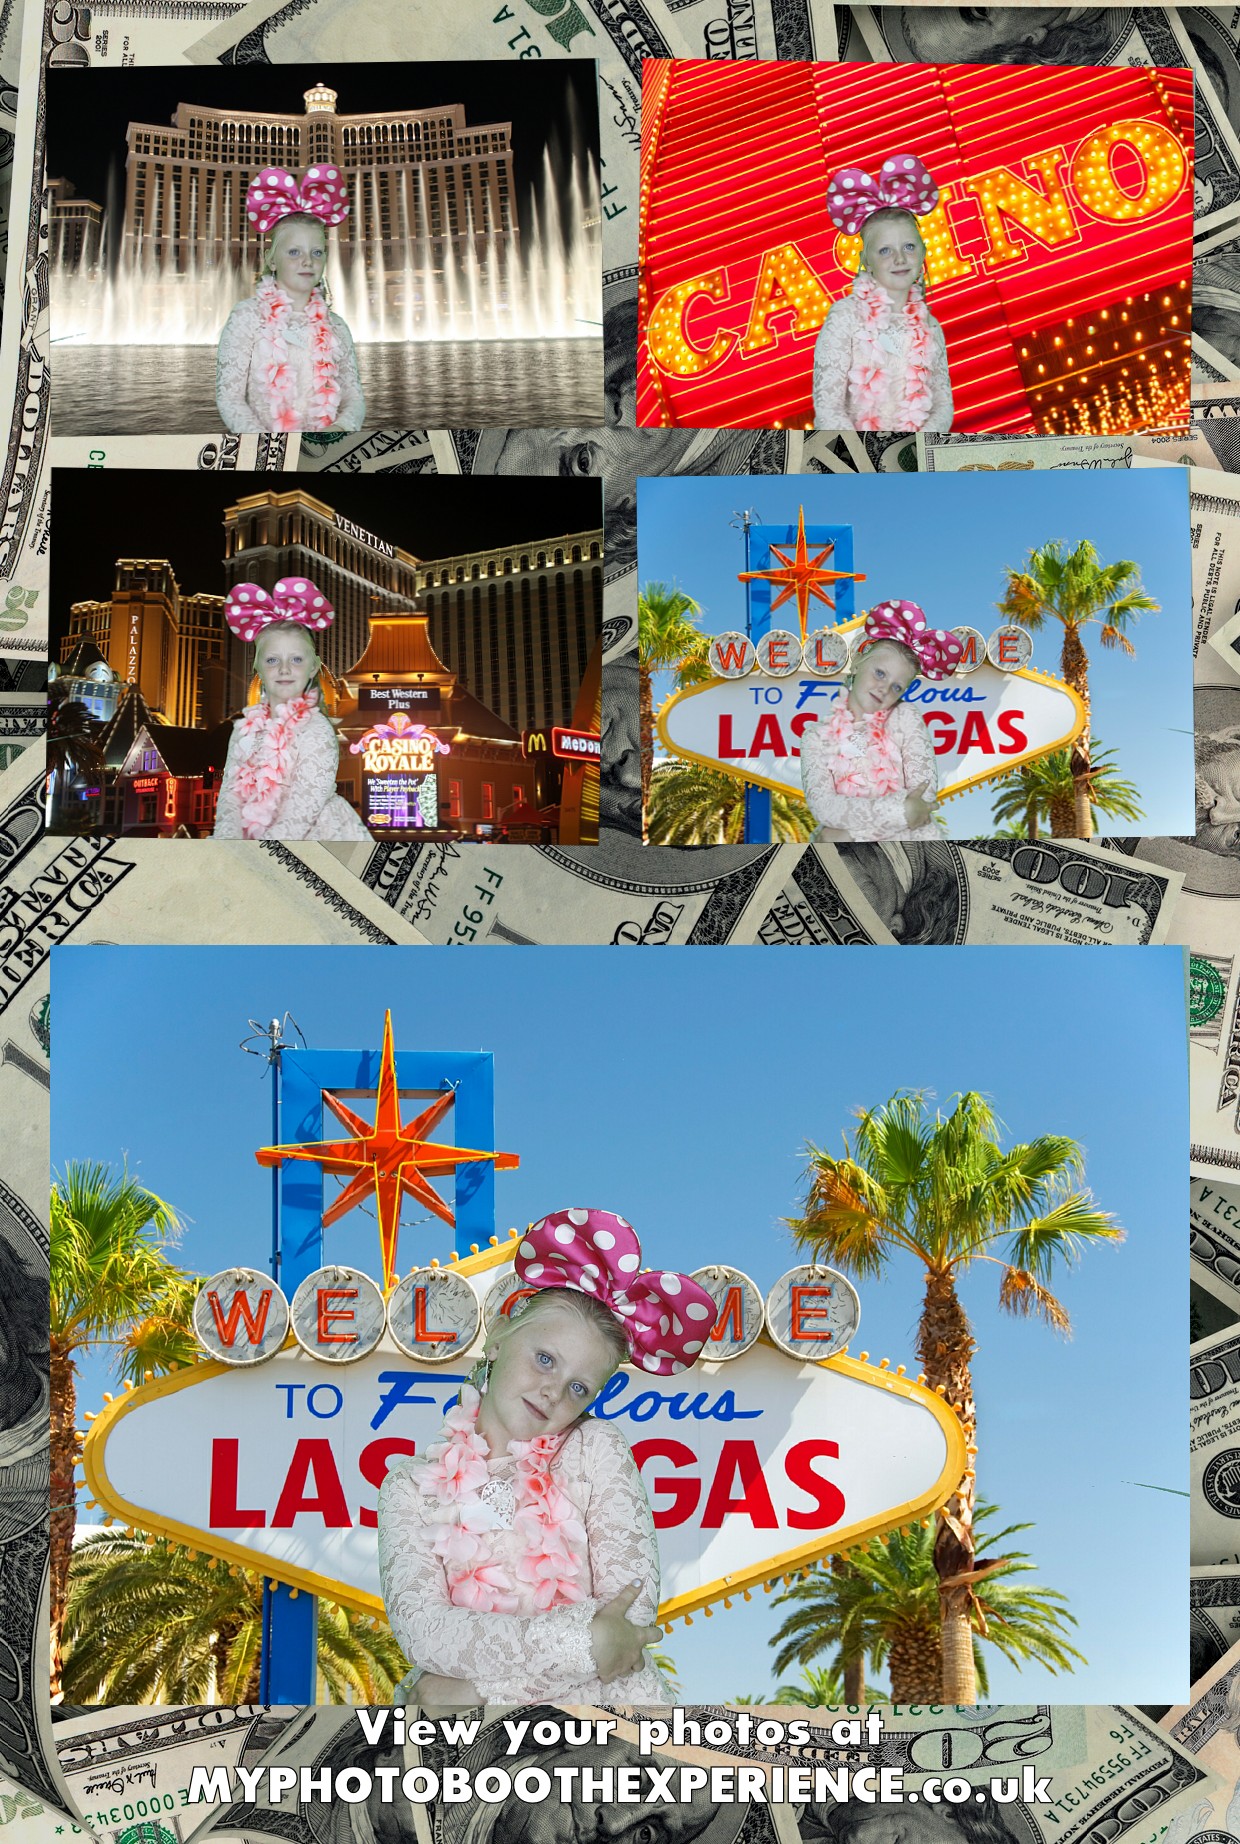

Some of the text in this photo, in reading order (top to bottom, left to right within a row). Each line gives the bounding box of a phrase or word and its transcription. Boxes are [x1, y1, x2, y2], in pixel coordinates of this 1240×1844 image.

[101, 30, 109, 57] SERIES
[30, 284, 38, 331] GRANT
[335, 513, 394, 557] VENETIAN
[1217, 549, 1225, 564] THIS
[1213, 567, 1222, 584] NOTE
[1200, 589, 1210, 612] PUBLIC
[1207, 596, 1216, 615] LEGAL
[1201, 617, 1211, 644] TENDER
[127, 615, 139, 684] PALAZZO
[715, 635, 1020, 670] WELME
[370, 689, 428, 699] Best Western
[749, 679, 987, 709] TO Flous
[388, 700, 410, 710] Plus
[922, 710, 1028, 755] GAS
[368, 738, 431, 755] CASINO
[362, 752, 434, 773] ROYALE
[133, 778, 159, 788] OUTBACK
[977, 870, 1002, 882] SERIES
[982, 865, 1000, 876] 2003
[991, 904, 1019, 918] PRIVATE
[1019, 914, 1035, 924] AND
[1003, 916, 1032, 929] TENDER
[1032, 925, 1055, 937] LEGAL
[1035, 919, 1062, 932] PUBLIC
[206, 1286, 833, 1348] WELME
[275, 1371, 764, 1430] TO Flous
[1196, 1427, 1222, 1442] PUBLIC
[1197, 1435, 1220, 1449] LEGAL
[629, 1438, 846, 1530] GAS
[1109, 1724, 1134, 1744] F6
[1043, 1740, 1152, 1824] FF 95594731 A
[1126, 1757, 1170, 1791] FEDERAL
[1080, 1784, 1126, 1826] RESERVE
